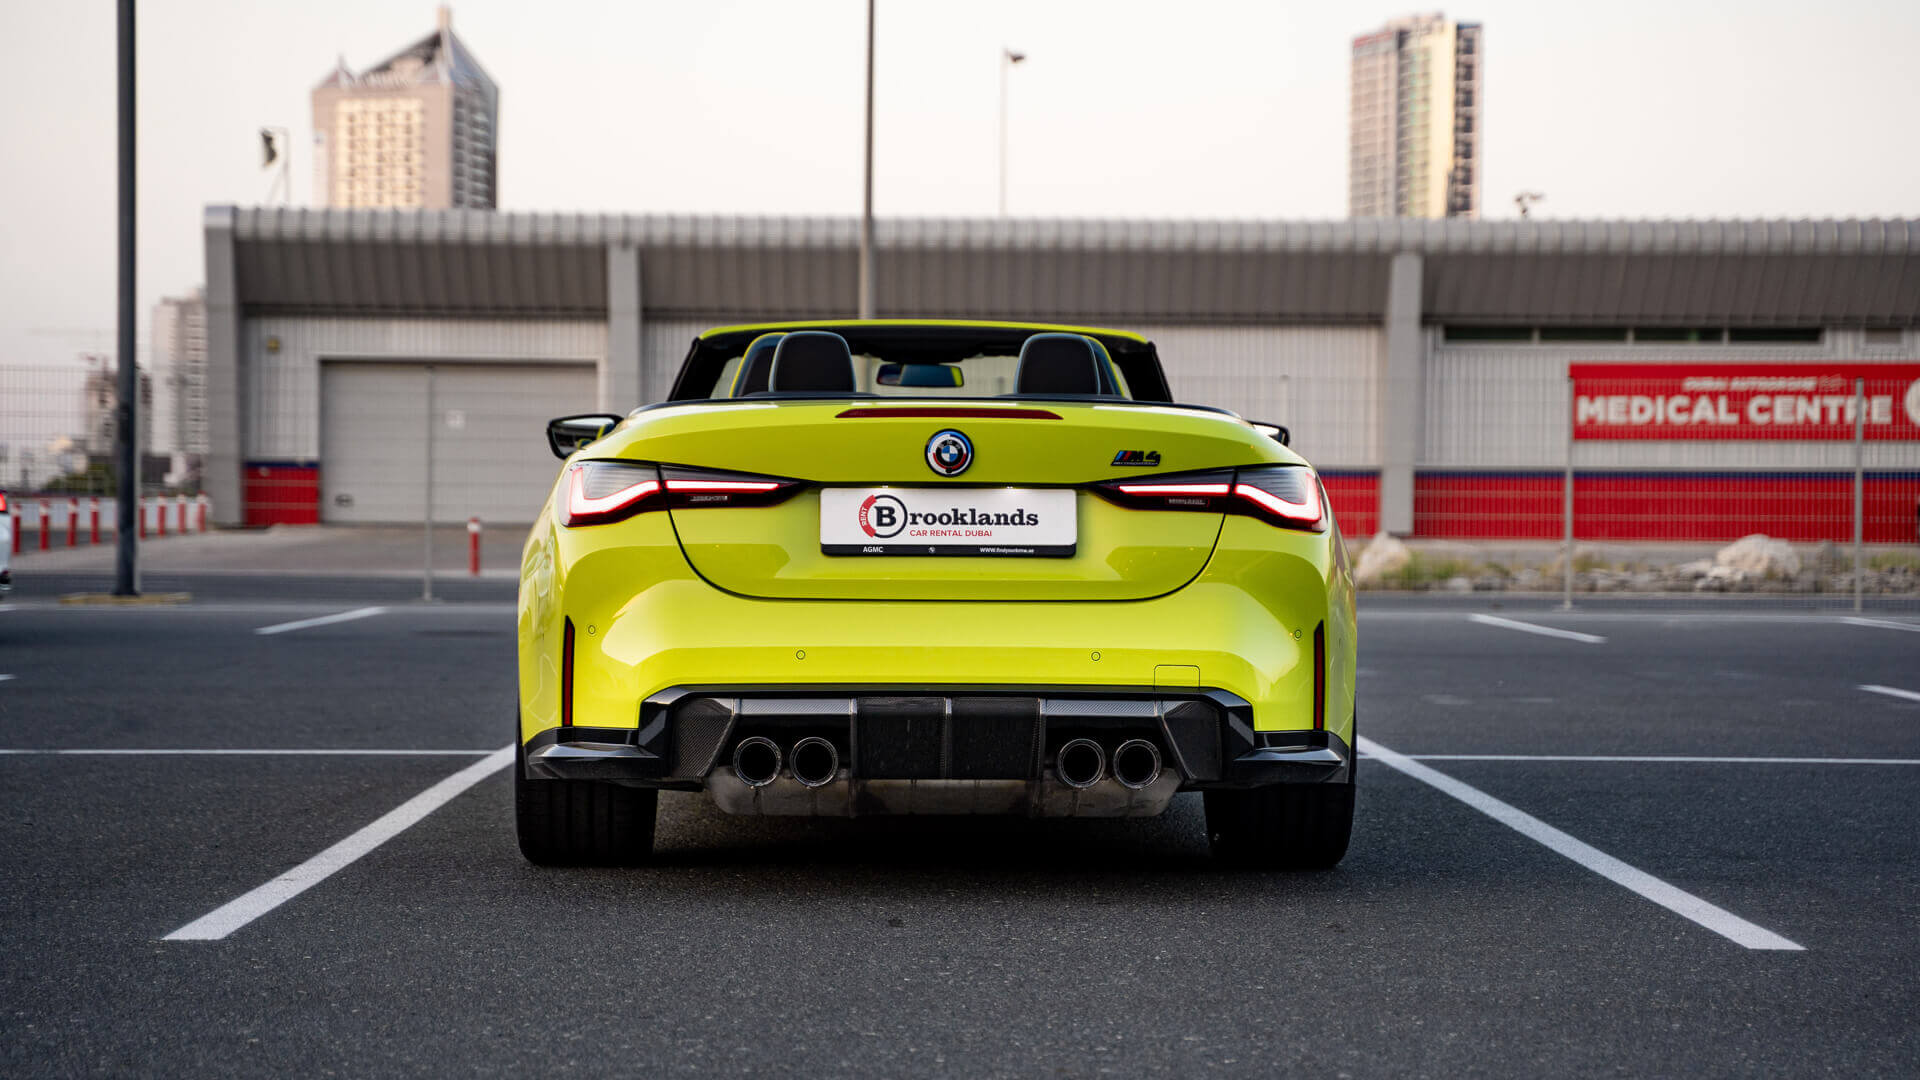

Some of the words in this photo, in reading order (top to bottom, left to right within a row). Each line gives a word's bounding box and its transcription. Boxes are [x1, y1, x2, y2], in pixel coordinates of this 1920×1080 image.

[1577, 395, 1739, 425] MEDICAL
[1747, 395, 1893, 425] CENTRE
[909, 529, 928, 537] CAR
[930, 529, 963, 537] RENTAL
